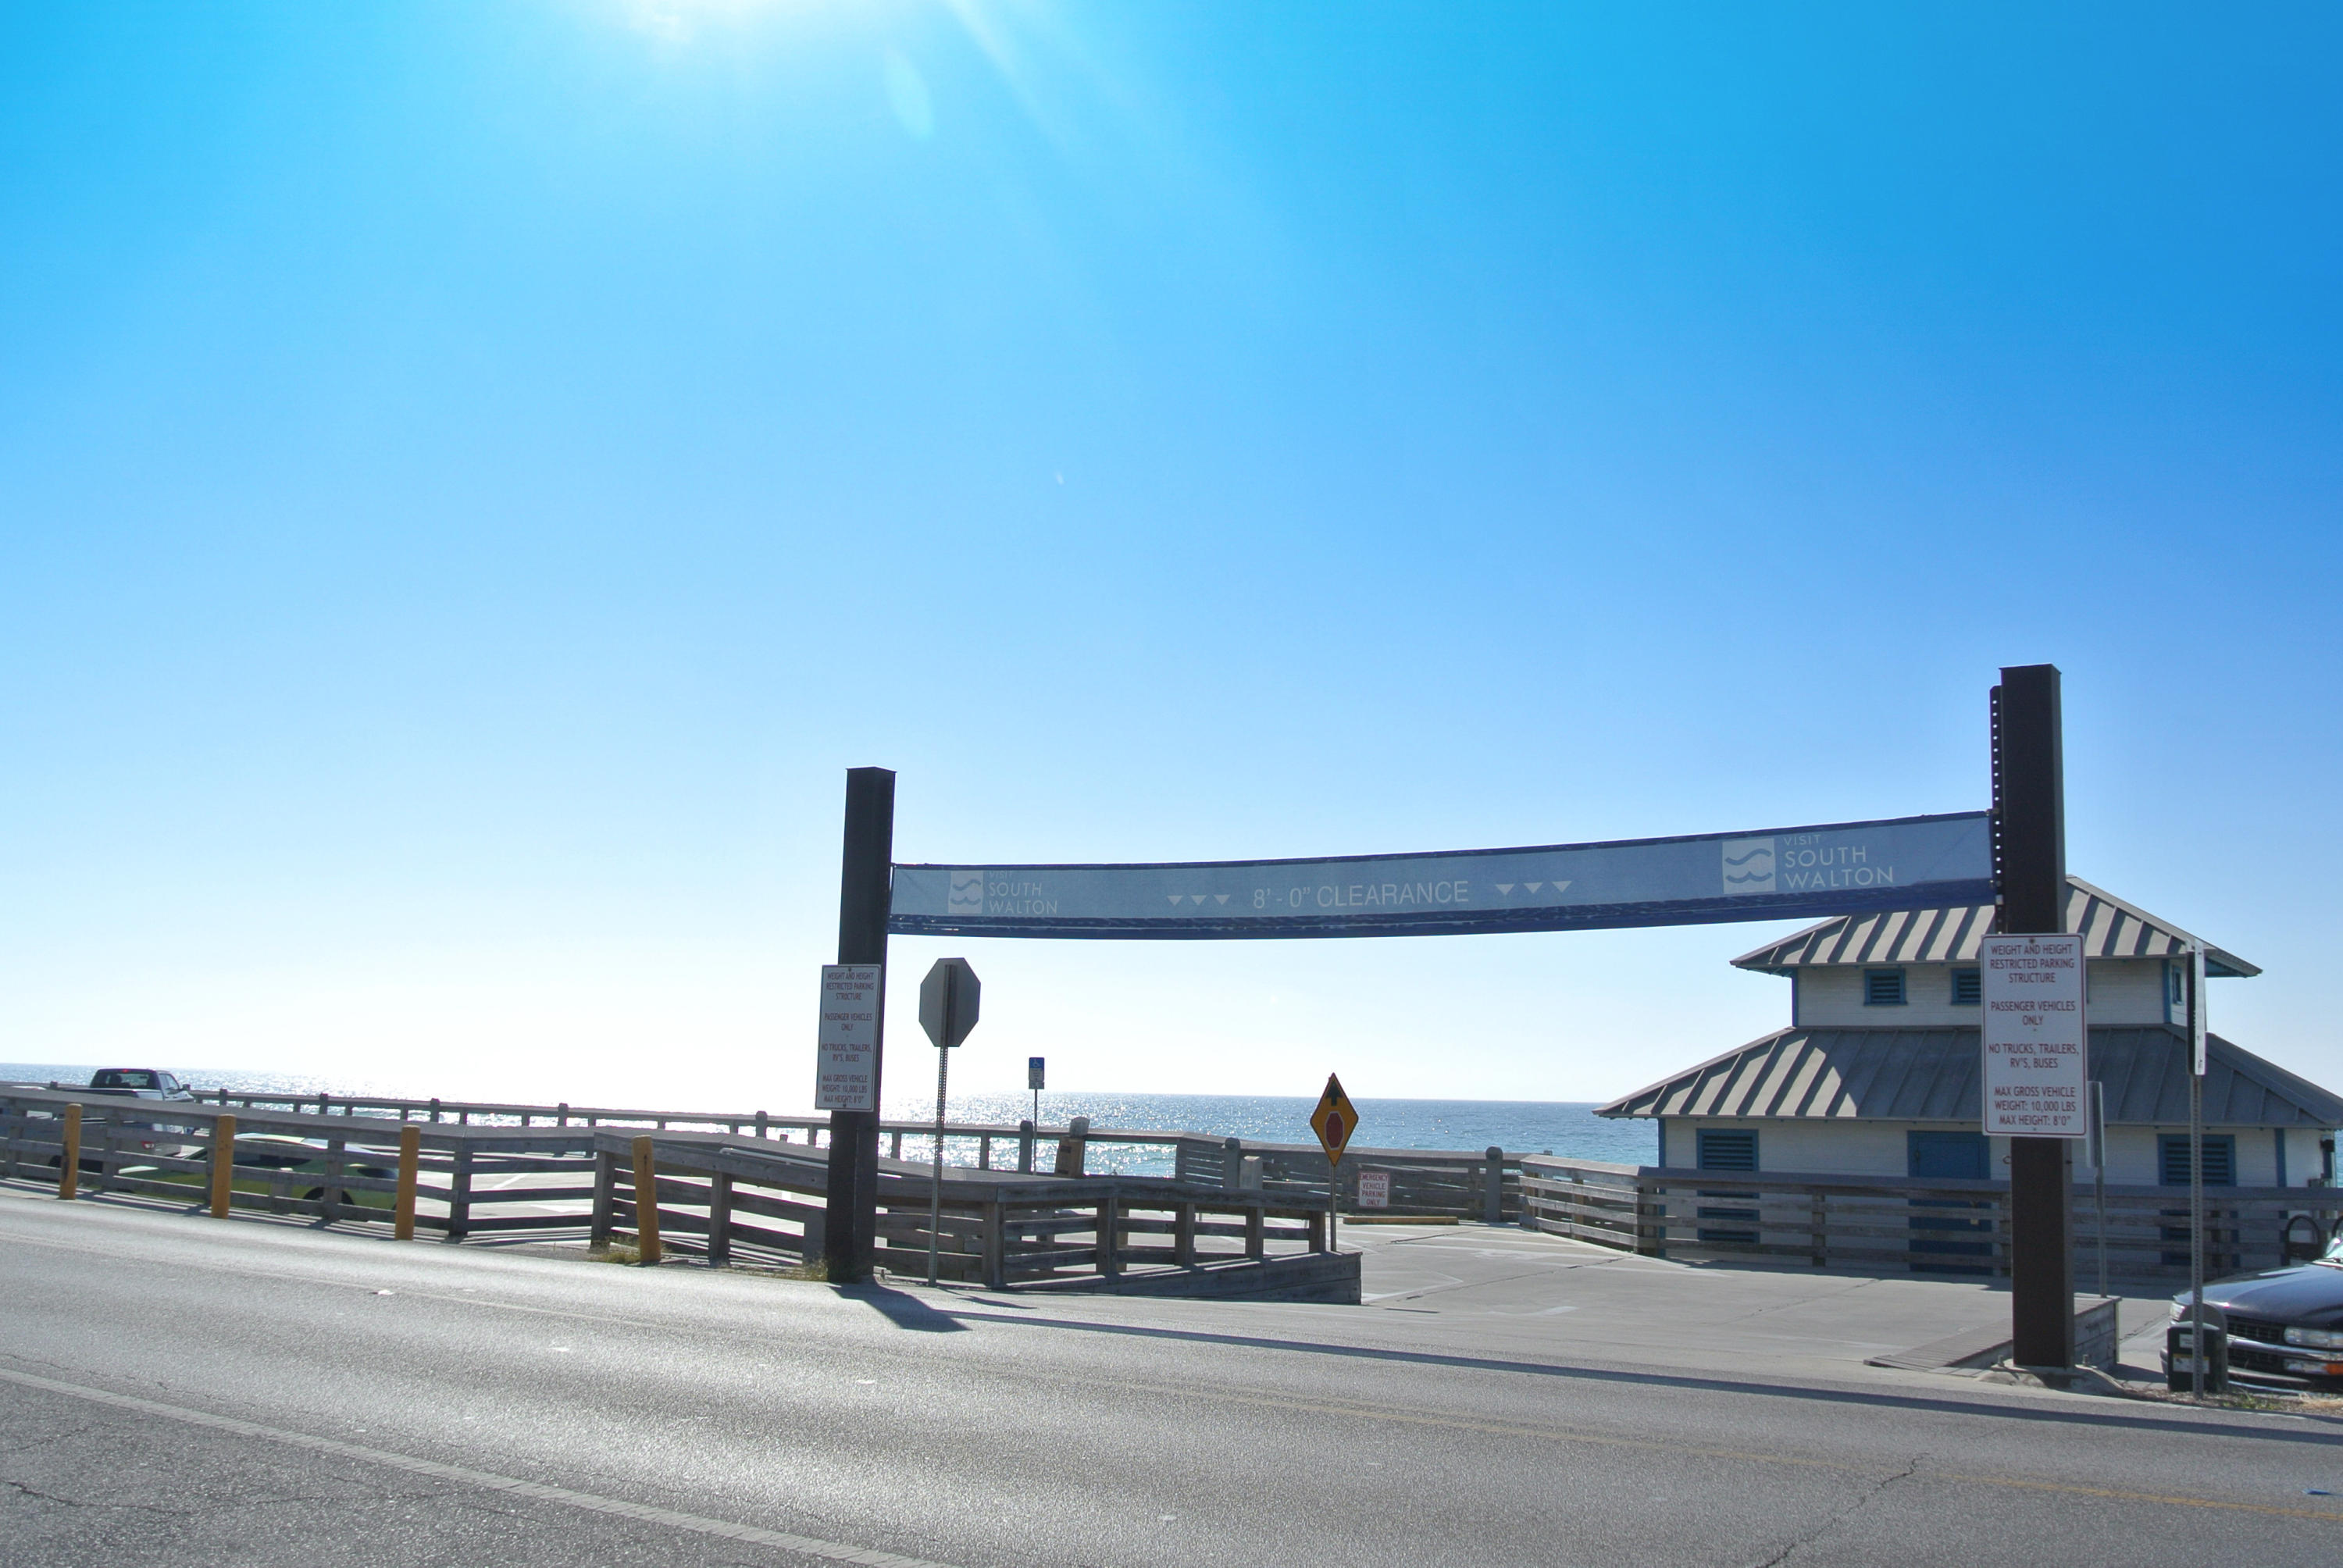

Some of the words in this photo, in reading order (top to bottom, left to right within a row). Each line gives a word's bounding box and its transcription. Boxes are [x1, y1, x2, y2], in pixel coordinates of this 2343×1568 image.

[1783, 835, 1821, 845] VISIT
[1785, 846, 1867, 868] SOUTH
[1785, 866, 1893, 889] WALTON
[989, 882, 1042, 896] SOUTH
[1317, 881, 1469, 907] CLEARANCE
[989, 900, 1057, 914] WALTON
[1991, 945, 2021, 955] WEIGHT
[2024, 945, 2040, 954] AND
[2043, 944, 2072, 954] HEIGHT
[1991, 959, 2037, 968] RESTRICTED
[2040, 958, 2074, 968] PARKING
[2009, 973, 2056, 983] STRUCTURE
[1991, 1001, 2035, 1010] PASSENGER
[2038, 1001, 2075, 1010] VEHICLES
[2023, 1016, 2043, 1025] ONLY
[1989, 1044, 2000, 1053] NO
[2002, 1044, 2036, 1055] TRUCKS,
[2039, 1044, 2079, 1055] TRAILERS,
[2010, 1058, 2031, 1069] RV'S,
[2034, 1058, 2058, 1068] BUSES
[1995, 1087, 2011, 1097] MAX
[2014, 1087, 2039, 1097] GROSS
[2042, 1088, 2075, 1097] VEHICLE
[1995, 1101, 2027, 1110] WEIGHT:
[2031, 1101, 2059, 1112] 10,000
[2061, 1102, 2076, 1112] LBS
[1999, 1115, 2017, 1124] MAX
[2019, 1116, 2050, 1125] HEIGHT:
[2053, 1116, 2070, 1126] 8'0"
